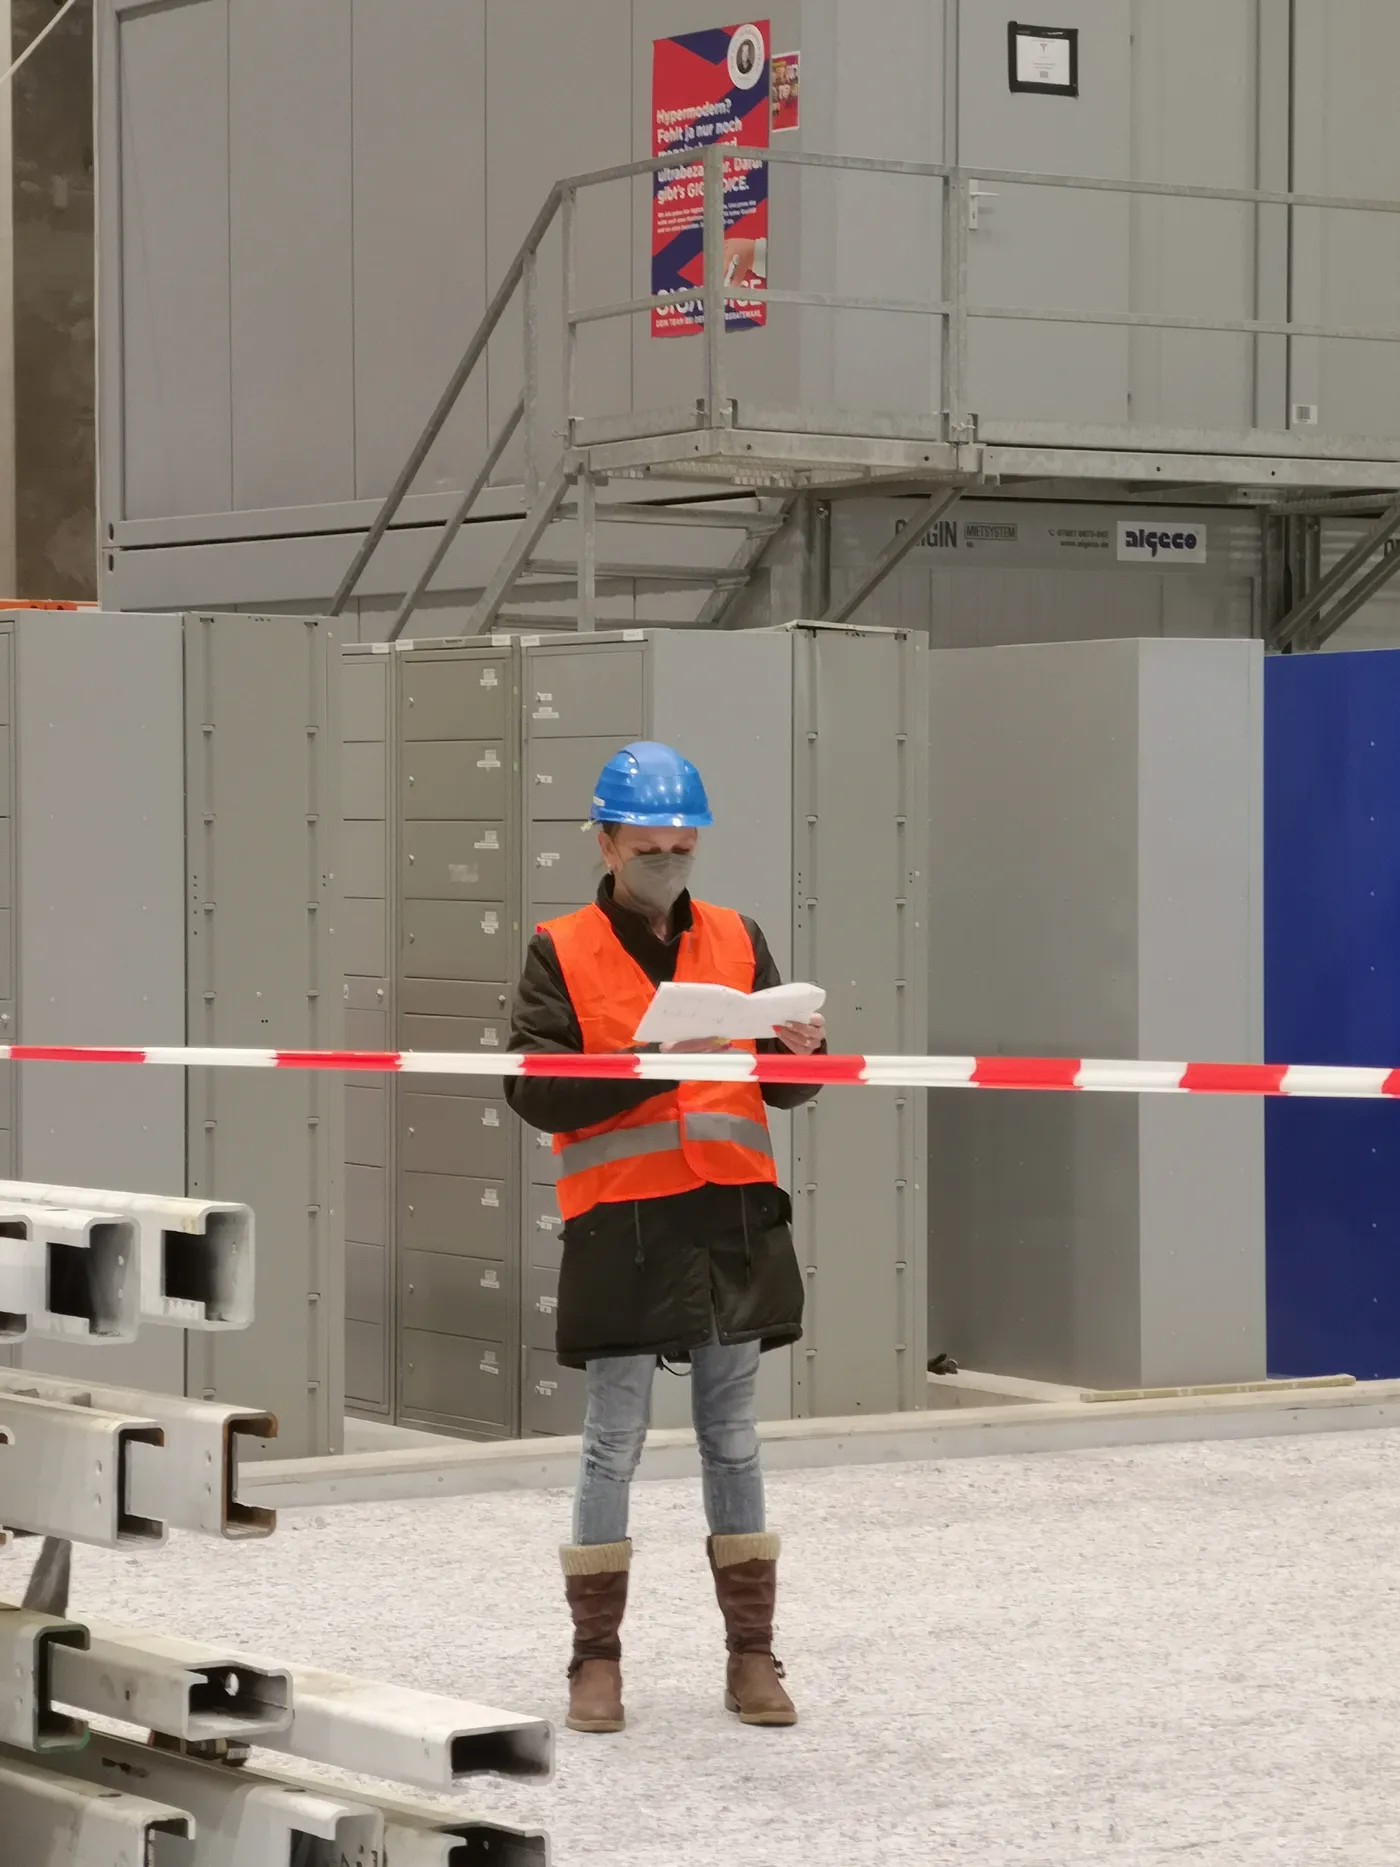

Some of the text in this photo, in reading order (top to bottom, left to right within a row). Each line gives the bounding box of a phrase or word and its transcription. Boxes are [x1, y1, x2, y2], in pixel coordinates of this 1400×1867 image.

[656, 98, 732, 126] Hypermodern?
[657, 116, 742, 144] Fehlt ja nur noch
[966, 526, 1014, 538] MIETSYSTEM
[1125, 528, 1197, 558] algeco
